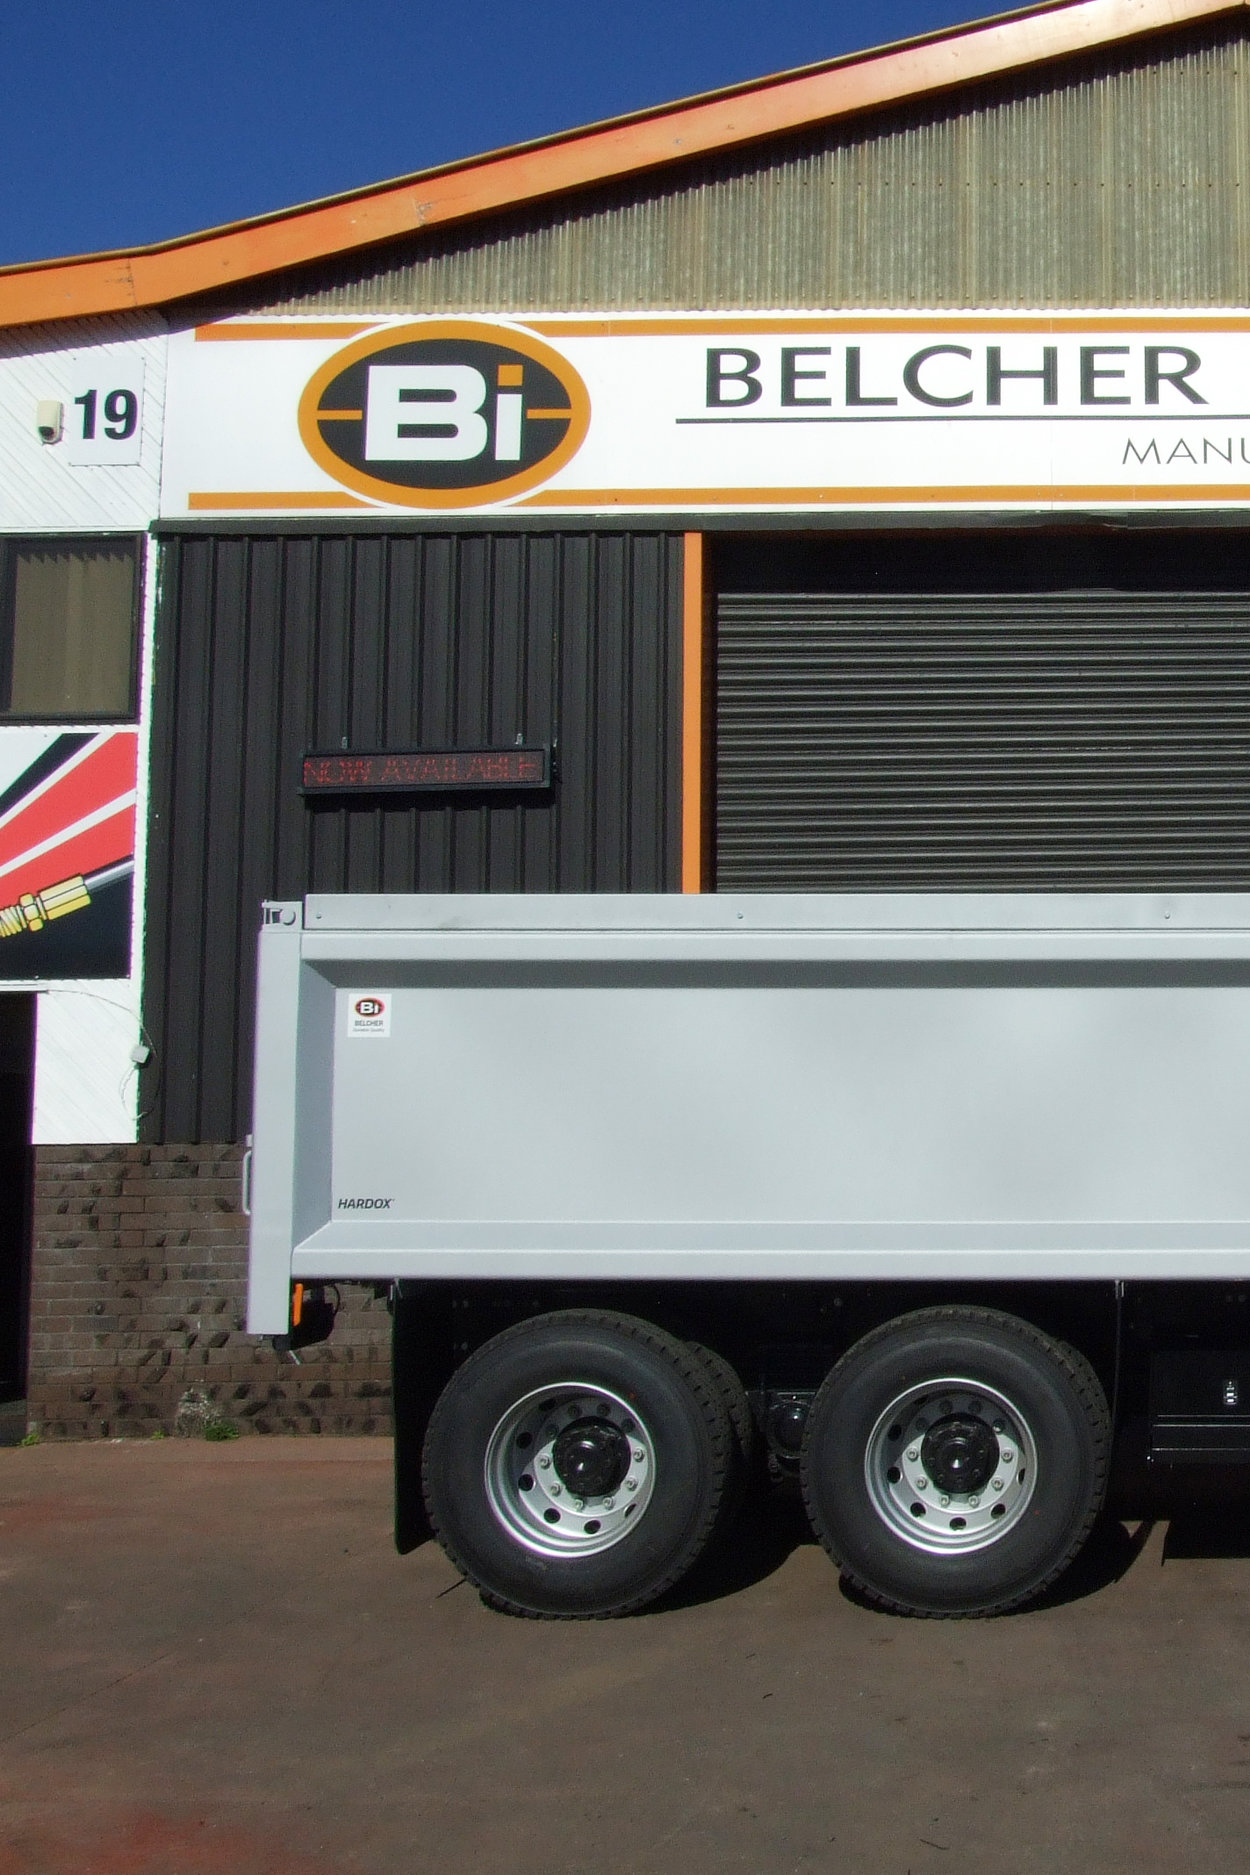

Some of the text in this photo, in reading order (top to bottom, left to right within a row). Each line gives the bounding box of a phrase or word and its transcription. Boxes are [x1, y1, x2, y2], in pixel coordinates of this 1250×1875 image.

[706, 344, 1210, 408] BELCHER
[74, 389, 138, 440] 19
[364, 364, 524, 461] Bi
[303, 755, 537, 786] NOW AVAILABLE
[337, 1198, 392, 1209] HARDOX
